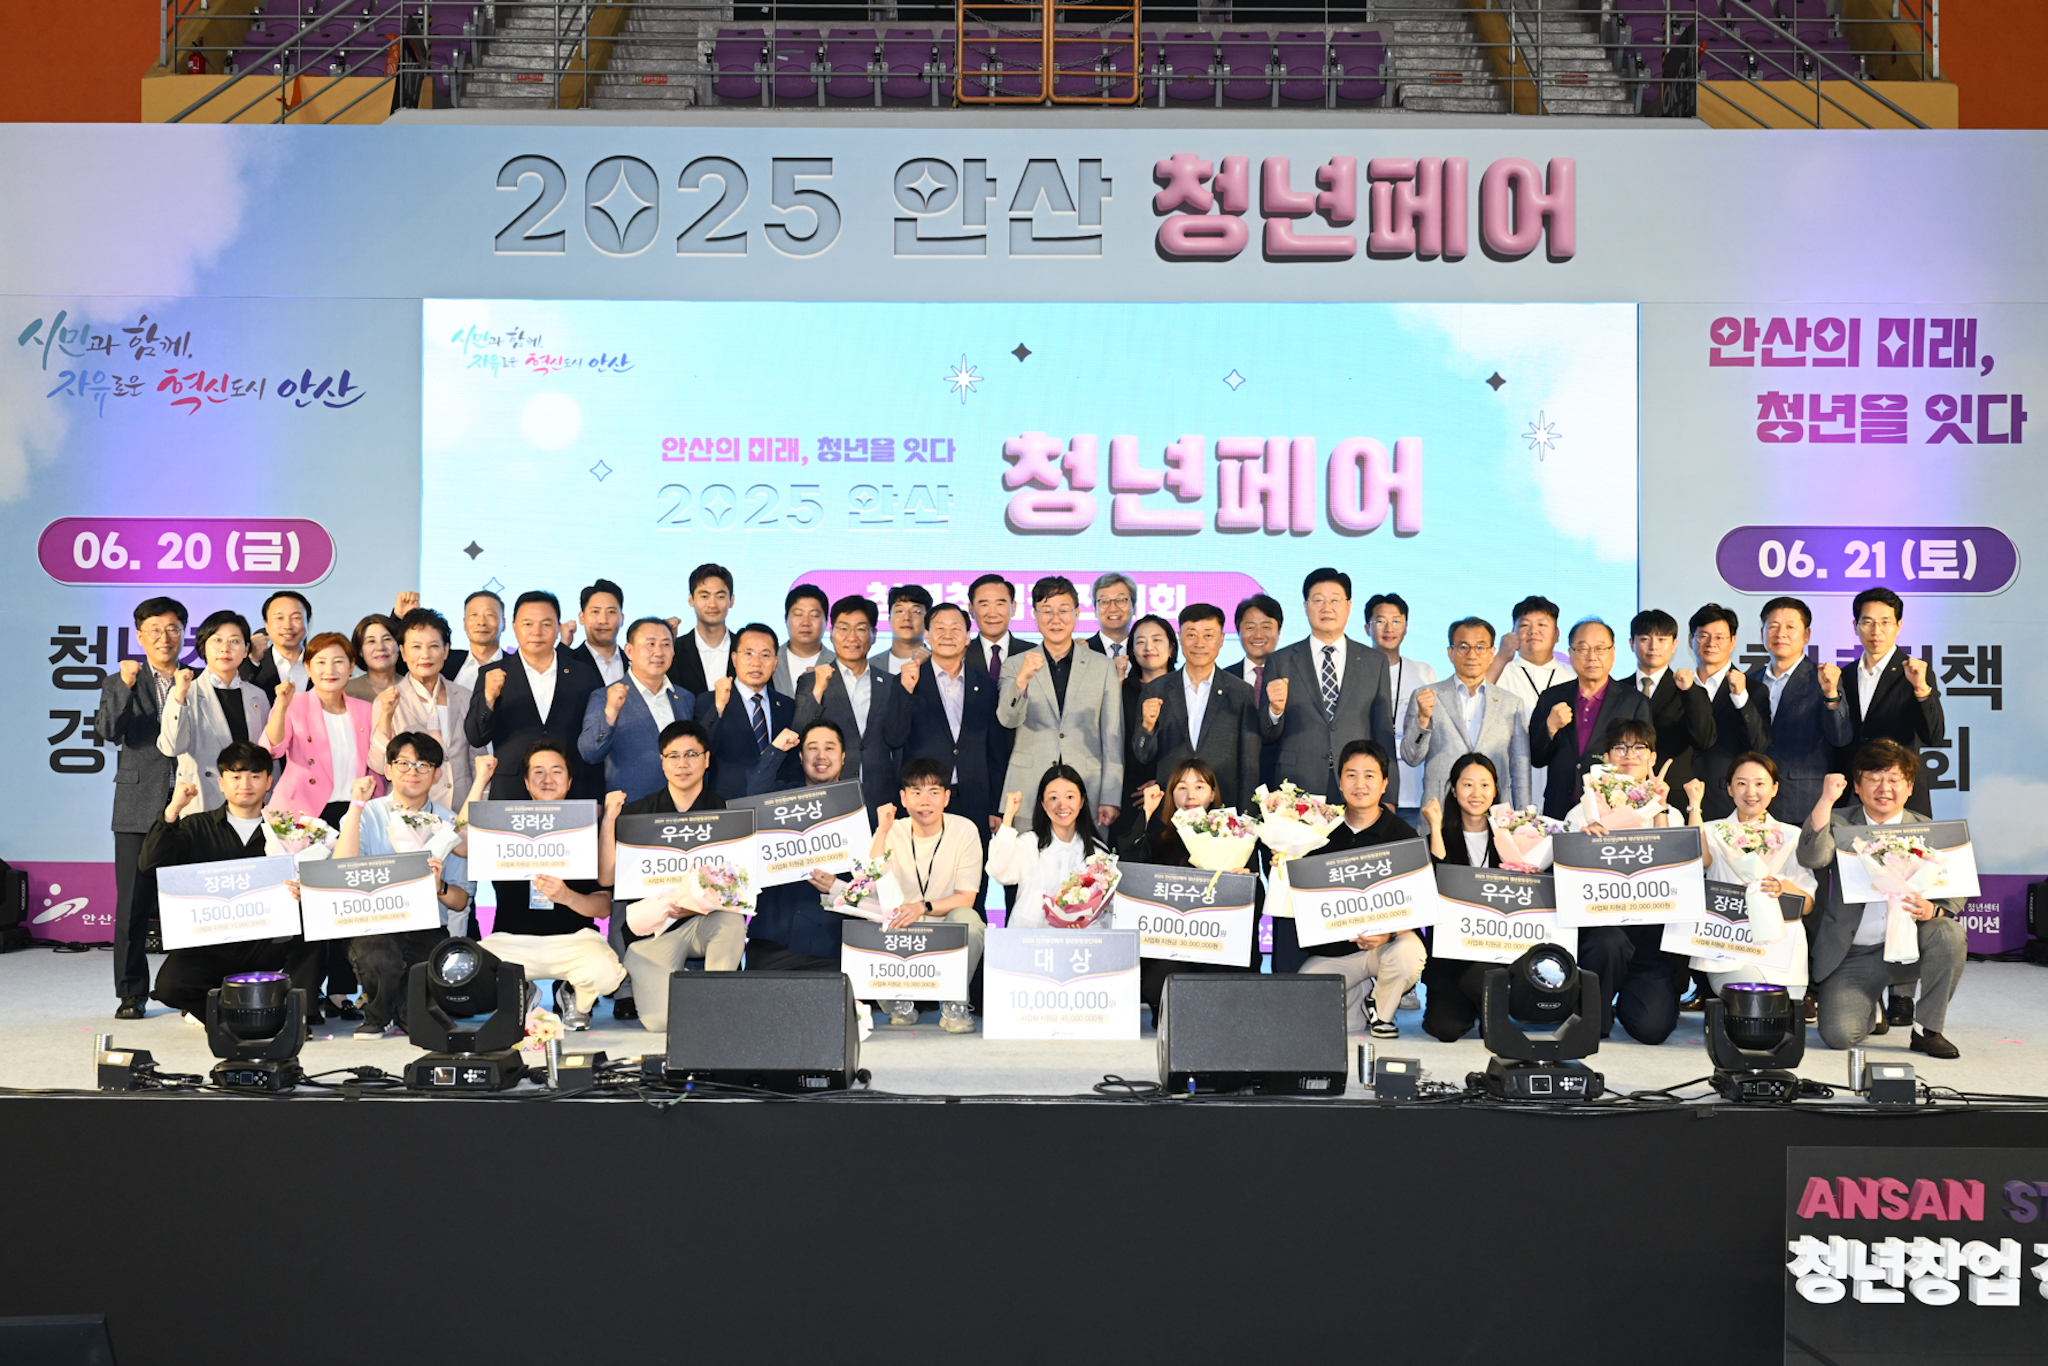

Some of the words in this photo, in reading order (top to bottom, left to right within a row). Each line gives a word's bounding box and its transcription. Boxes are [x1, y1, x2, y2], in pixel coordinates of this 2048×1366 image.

[495, 154, 842, 258] 2025
[894, 157, 1113, 258] 안산
[1154, 153, 1576, 260] 청년페어
[18, 310, 120, 370] 시민과
[451, 324, 504, 354] 시민과
[1709, 317, 1861, 367] 안산의
[1877, 318, 1994, 376] 미래,
[525, 352, 583, 376] 혁신도시
[588, 352, 636, 373] 안산
[47, 370, 145, 418] 자유로운
[157, 369, 266, 416] 혁신도시
[277, 369, 366, 408] 안산
[1757, 391, 1908, 444] 청년을
[1925, 394, 2028, 444] 잇다
[662, 437, 740, 463] 안산의
[748, 437, 809, 467] 미래,
[817, 437, 895, 463] 청년을
[903, 437, 956, 463] 잇다
[1002, 431, 1423, 537] 청년페어
[656, 484, 824, 532] 2025
[848, 484, 954, 532] 안산
[72, 531, 140, 570] 06.
[157, 531, 212, 570] 20
[225, 530, 301, 573] (금)
[1758, 539, 1828, 579] 06.
[1844, 540, 1886, 579] 21
[1901, 538, 1977, 581] (토)
[511, 814, 555, 830] 장려상
[774, 800, 823, 825] 우수상
[660, 823, 713, 843] 우수상
[1600, 844, 1654, 865] 우수상
[204, 873, 251, 893] 장려상
[345, 867, 391, 887] 장려상
[1329, 858, 1392, 883] 최우수상
[1153, 882, 1217, 904] 최우수상
[1481, 883, 1533, 905] 우수상
[1714, 895, 1749, 915] 장려
[82, 914, 116, 925] 안산
[884, 935, 927, 951] 장려상
[1796, 1176, 1985, 1221] ANSAN
[1786, 1235, 2021, 1306] 청년창업
